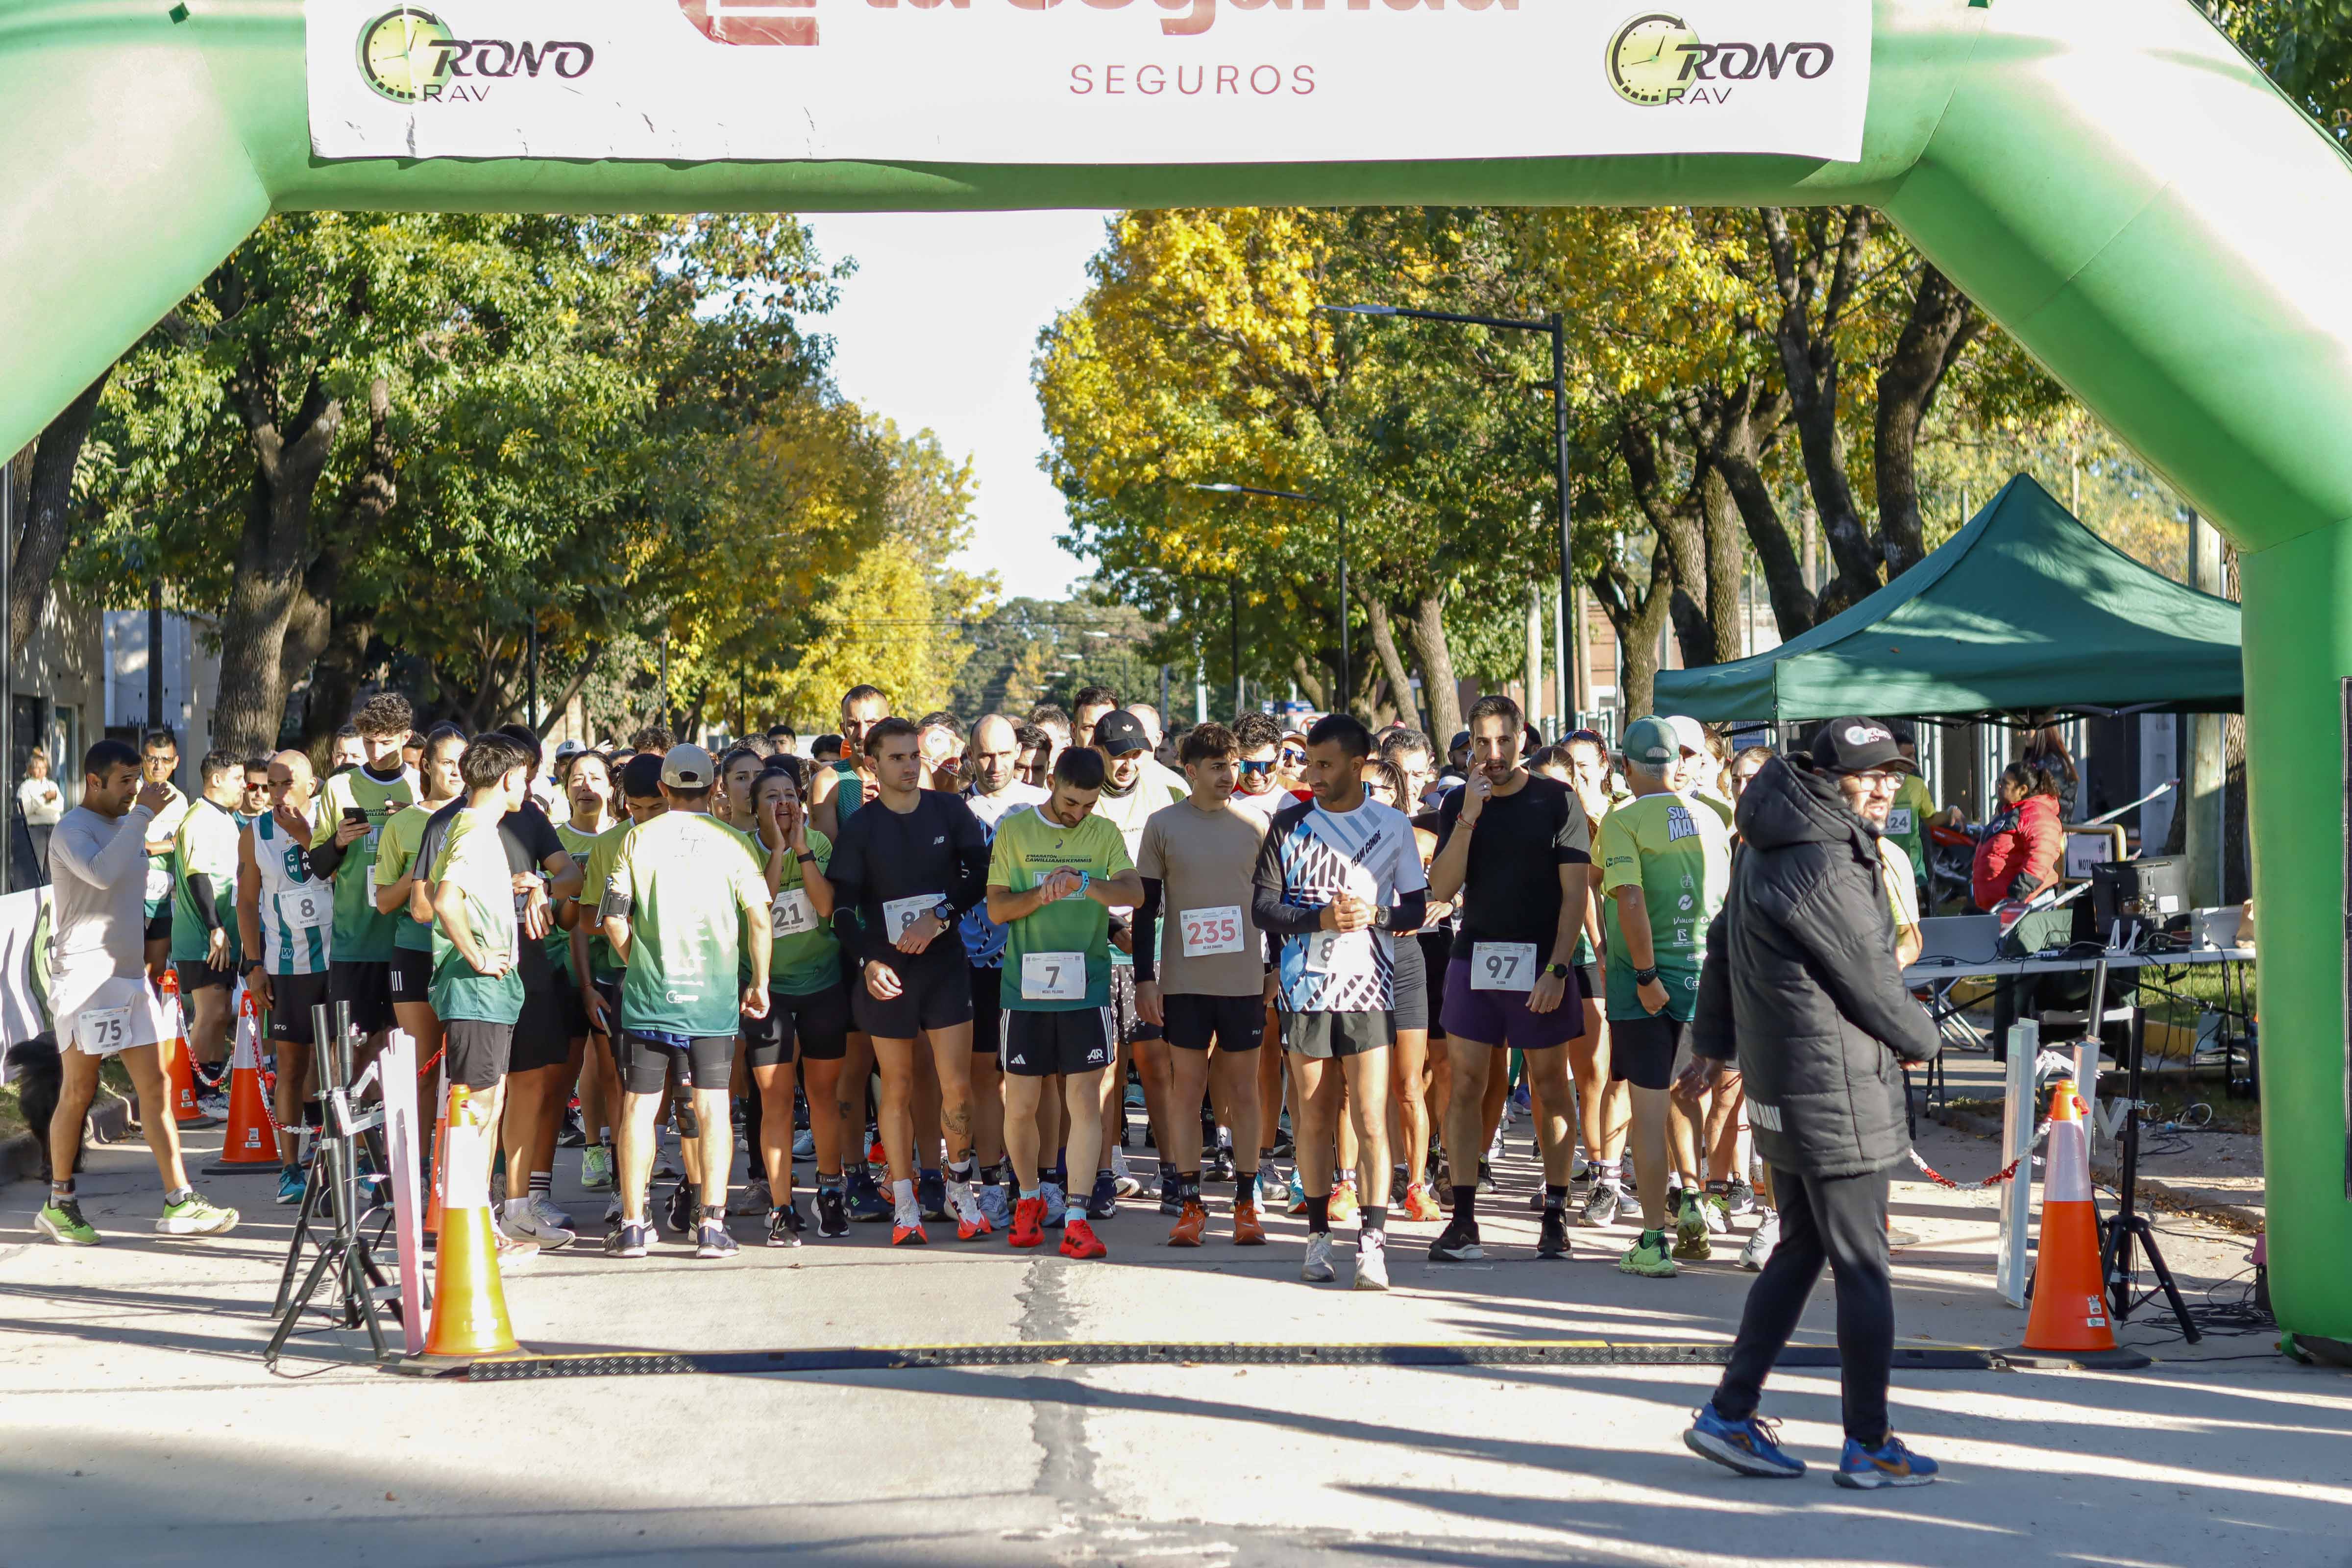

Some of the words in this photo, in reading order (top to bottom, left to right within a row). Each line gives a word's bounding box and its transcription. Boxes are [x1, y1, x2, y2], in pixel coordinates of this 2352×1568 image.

[1069, 64, 1315, 95] SEGUROS
[423, 84, 490, 102] RAV
[1666, 87, 1732, 105] RAV
[1666, 806, 1691, 819] SUP
[1886, 816, 1908, 828] 24
[1366, 829, 1381, 854] CONDE
[1351, 847, 1365, 869] TEAM
[300, 899, 315, 918] 8
[772, 903, 804, 928] 21
[1187, 919, 1236, 945] 235
[1045, 966, 1060, 988] 7
[1486, 956, 1519, 979] 97
[94, 1019, 122, 1043] 75
